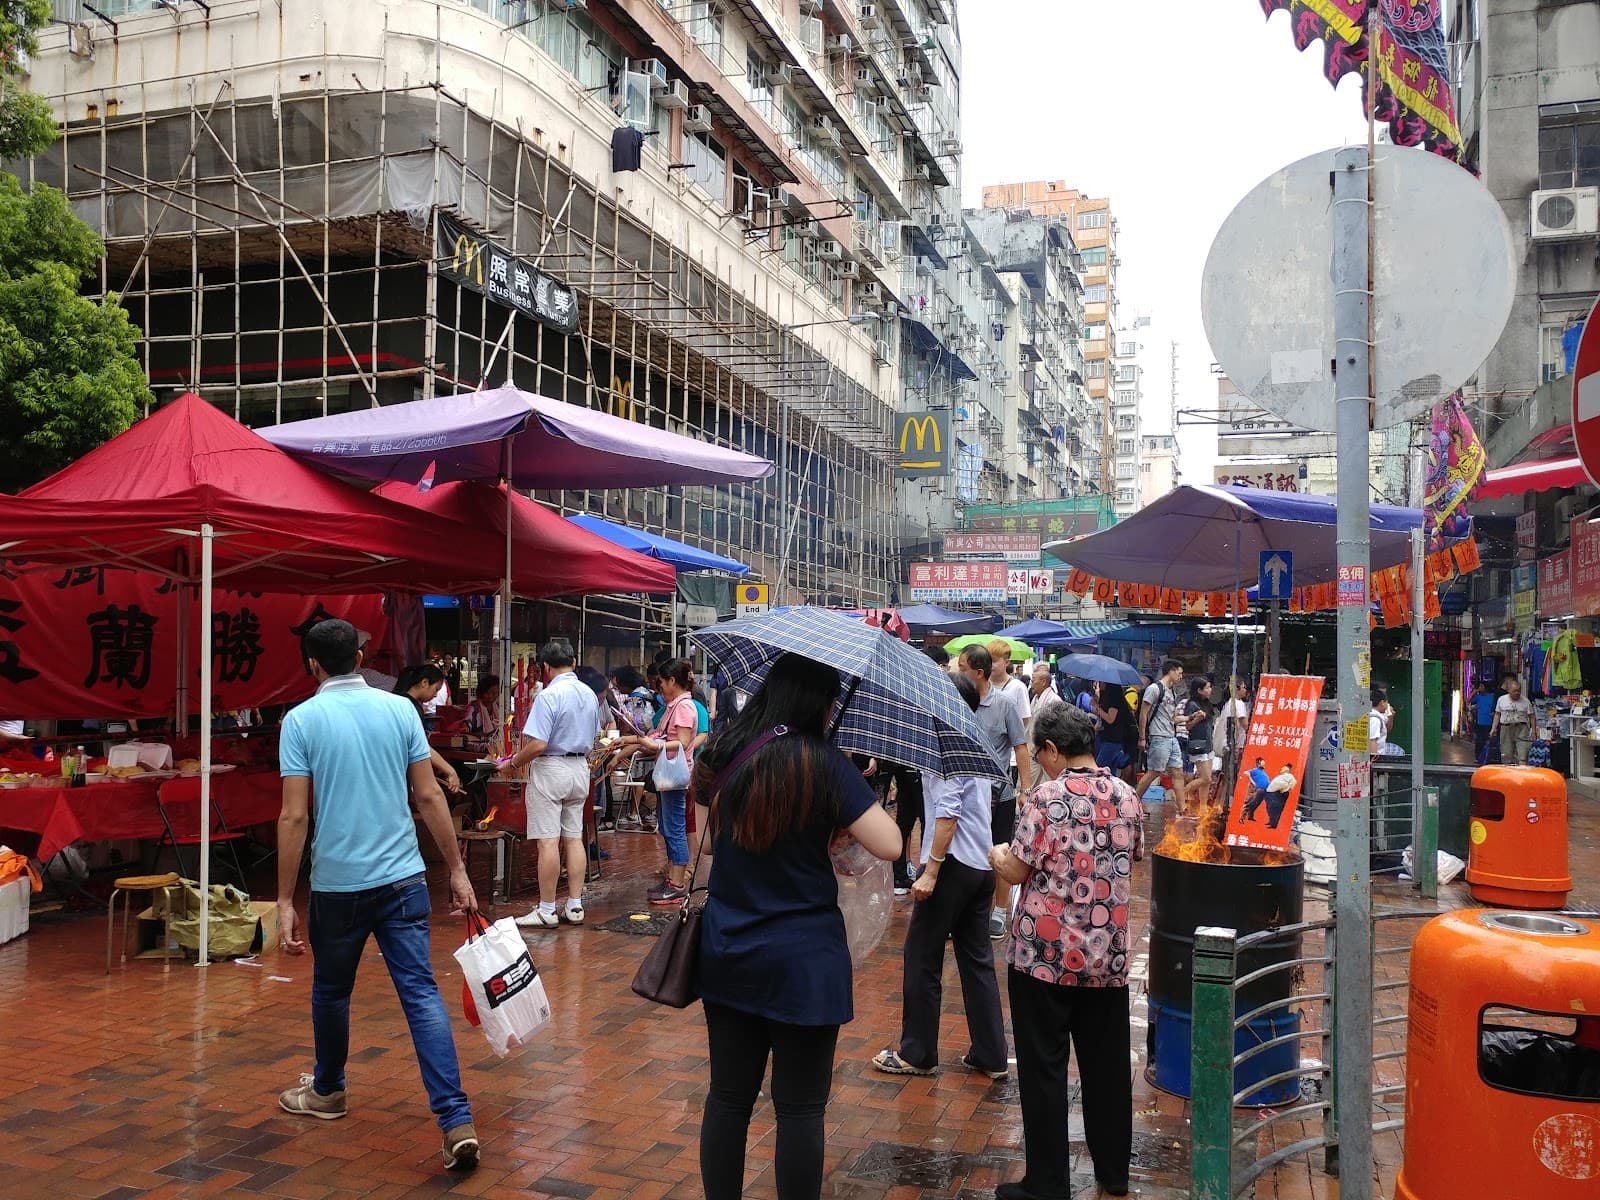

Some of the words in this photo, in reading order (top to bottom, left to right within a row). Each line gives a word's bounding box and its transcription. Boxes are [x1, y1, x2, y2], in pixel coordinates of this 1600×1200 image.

[489, 280, 532, 309] Business
[1339, 567, 1364, 580] 免佣
[745, 605, 760, 613] End
